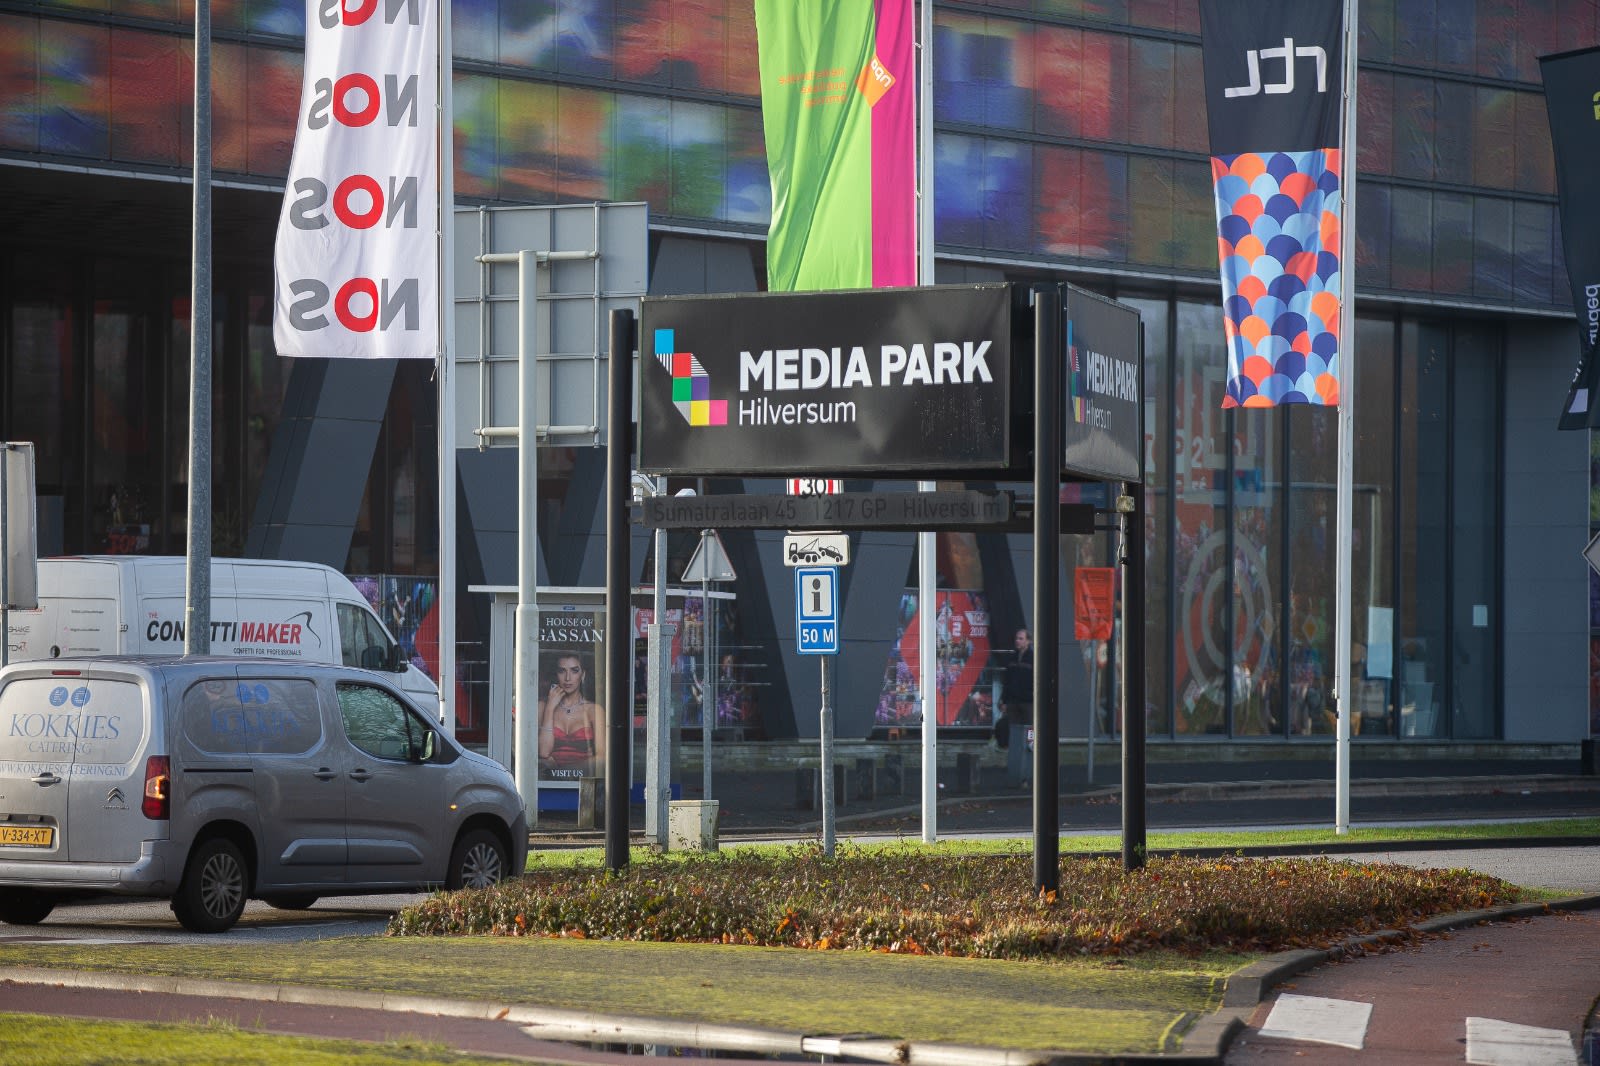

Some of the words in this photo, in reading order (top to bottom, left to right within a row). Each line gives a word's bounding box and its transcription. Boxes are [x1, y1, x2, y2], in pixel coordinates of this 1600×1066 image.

[739, 346, 873, 392] MEDIA
[881, 340, 994, 386] PARK
[1086, 350, 1115, 397] MEDIA
[1115, 359, 1138, 404] PARK
[738, 397, 856, 426] Hilversum
[801, 478, 827, 497] 30
[654, 499, 769, 522] Sumatralaan
[775, 499, 797, 520] 45
[813, 498, 855, 520] 1217
[862, 497, 887, 519] GP
[903, 496, 1000, 519] Hilversum
[546, 617, 579, 627] HOUSE
[580, 618, 594, 627] OF
[147, 620, 238, 642] CONTTI
[240, 622, 302, 645] MAKER
[802, 628, 819, 643] 50
[823, 628, 834, 643] M
[233, 647, 255, 655] CONFETTI
[266, 648, 302, 656] PROFESSIONALS
[9, 713, 121, 740] KOKKIES
[28, 741, 93, 755] CATERING
[551, 769, 572, 777] VISIT
[573, 769, 584, 778] US
[2, 829, 48, 843] V-334-XT
